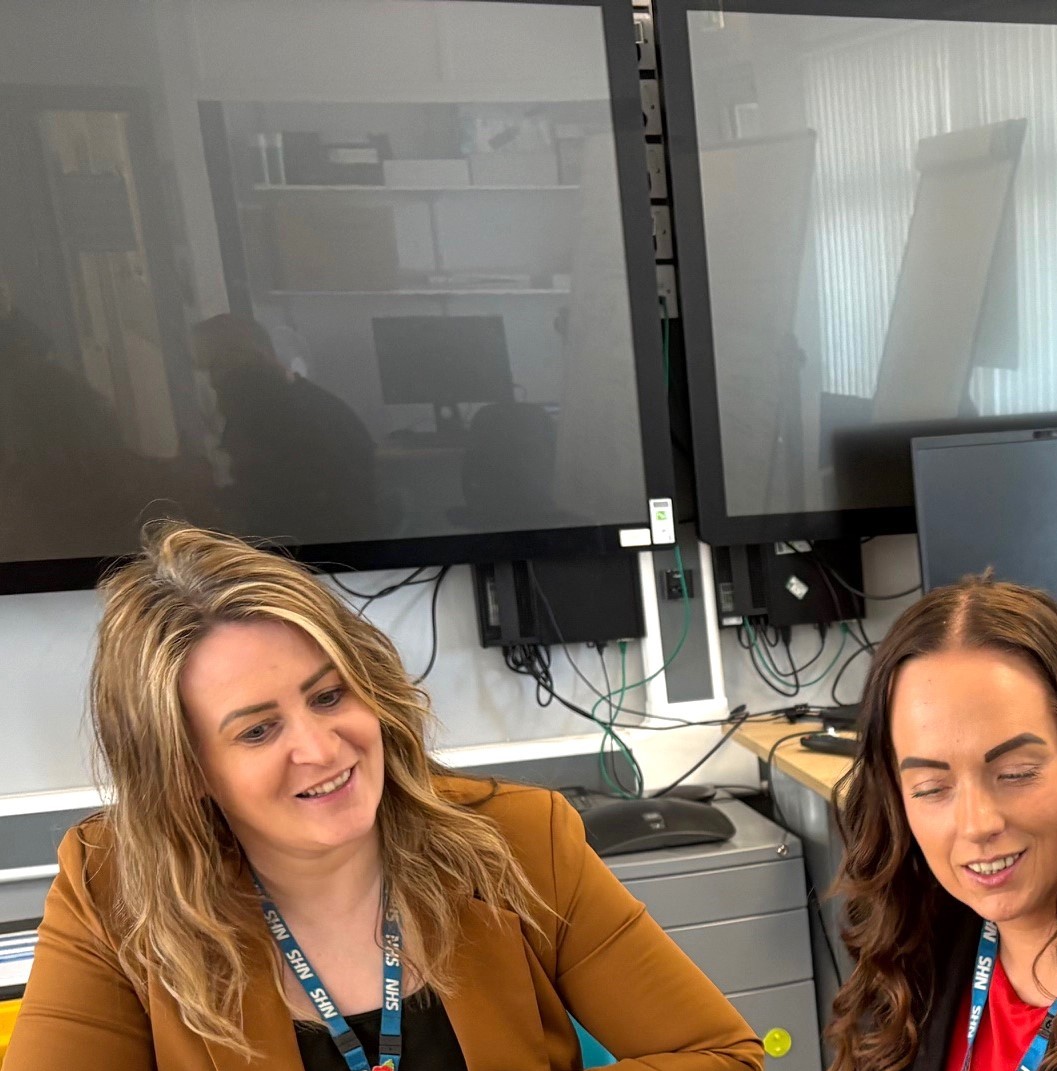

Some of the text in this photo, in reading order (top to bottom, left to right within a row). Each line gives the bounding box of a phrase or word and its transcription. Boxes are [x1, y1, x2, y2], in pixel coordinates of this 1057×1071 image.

[264, 910, 338, 1019] NHS NHS NHS
[385, 934, 400, 967] NHS
[974, 956, 992, 991] NHS
[385, 978, 399, 1011] NHS
[967, 1005, 982, 1039] NHS
